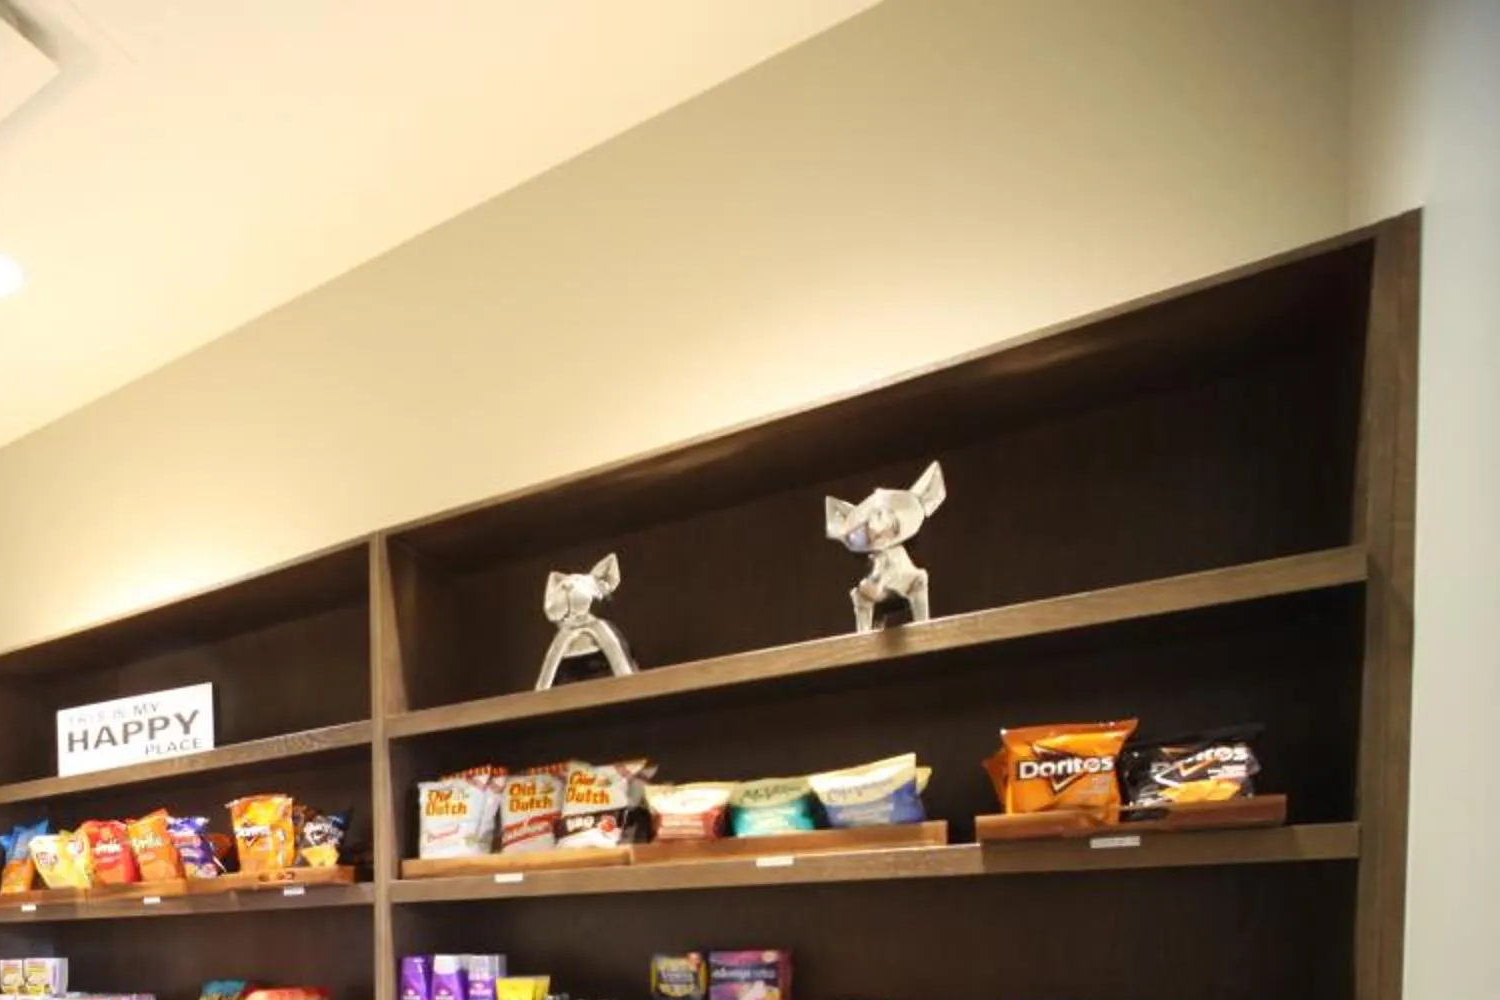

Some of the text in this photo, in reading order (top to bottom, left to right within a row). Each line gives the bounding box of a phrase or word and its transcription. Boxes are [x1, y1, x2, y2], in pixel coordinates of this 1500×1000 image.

[133, 701, 161, 717] MY
[67, 709, 199, 752] HAPPY
[145, 737, 203, 756] PLACE
[1019, 756, 1115, 779] Doritos
[509, 783, 537, 797] Old
[566, 788, 610, 805] Dutch
[425, 801, 467, 817] Dutch
[509, 797, 551, 813] Dutch
